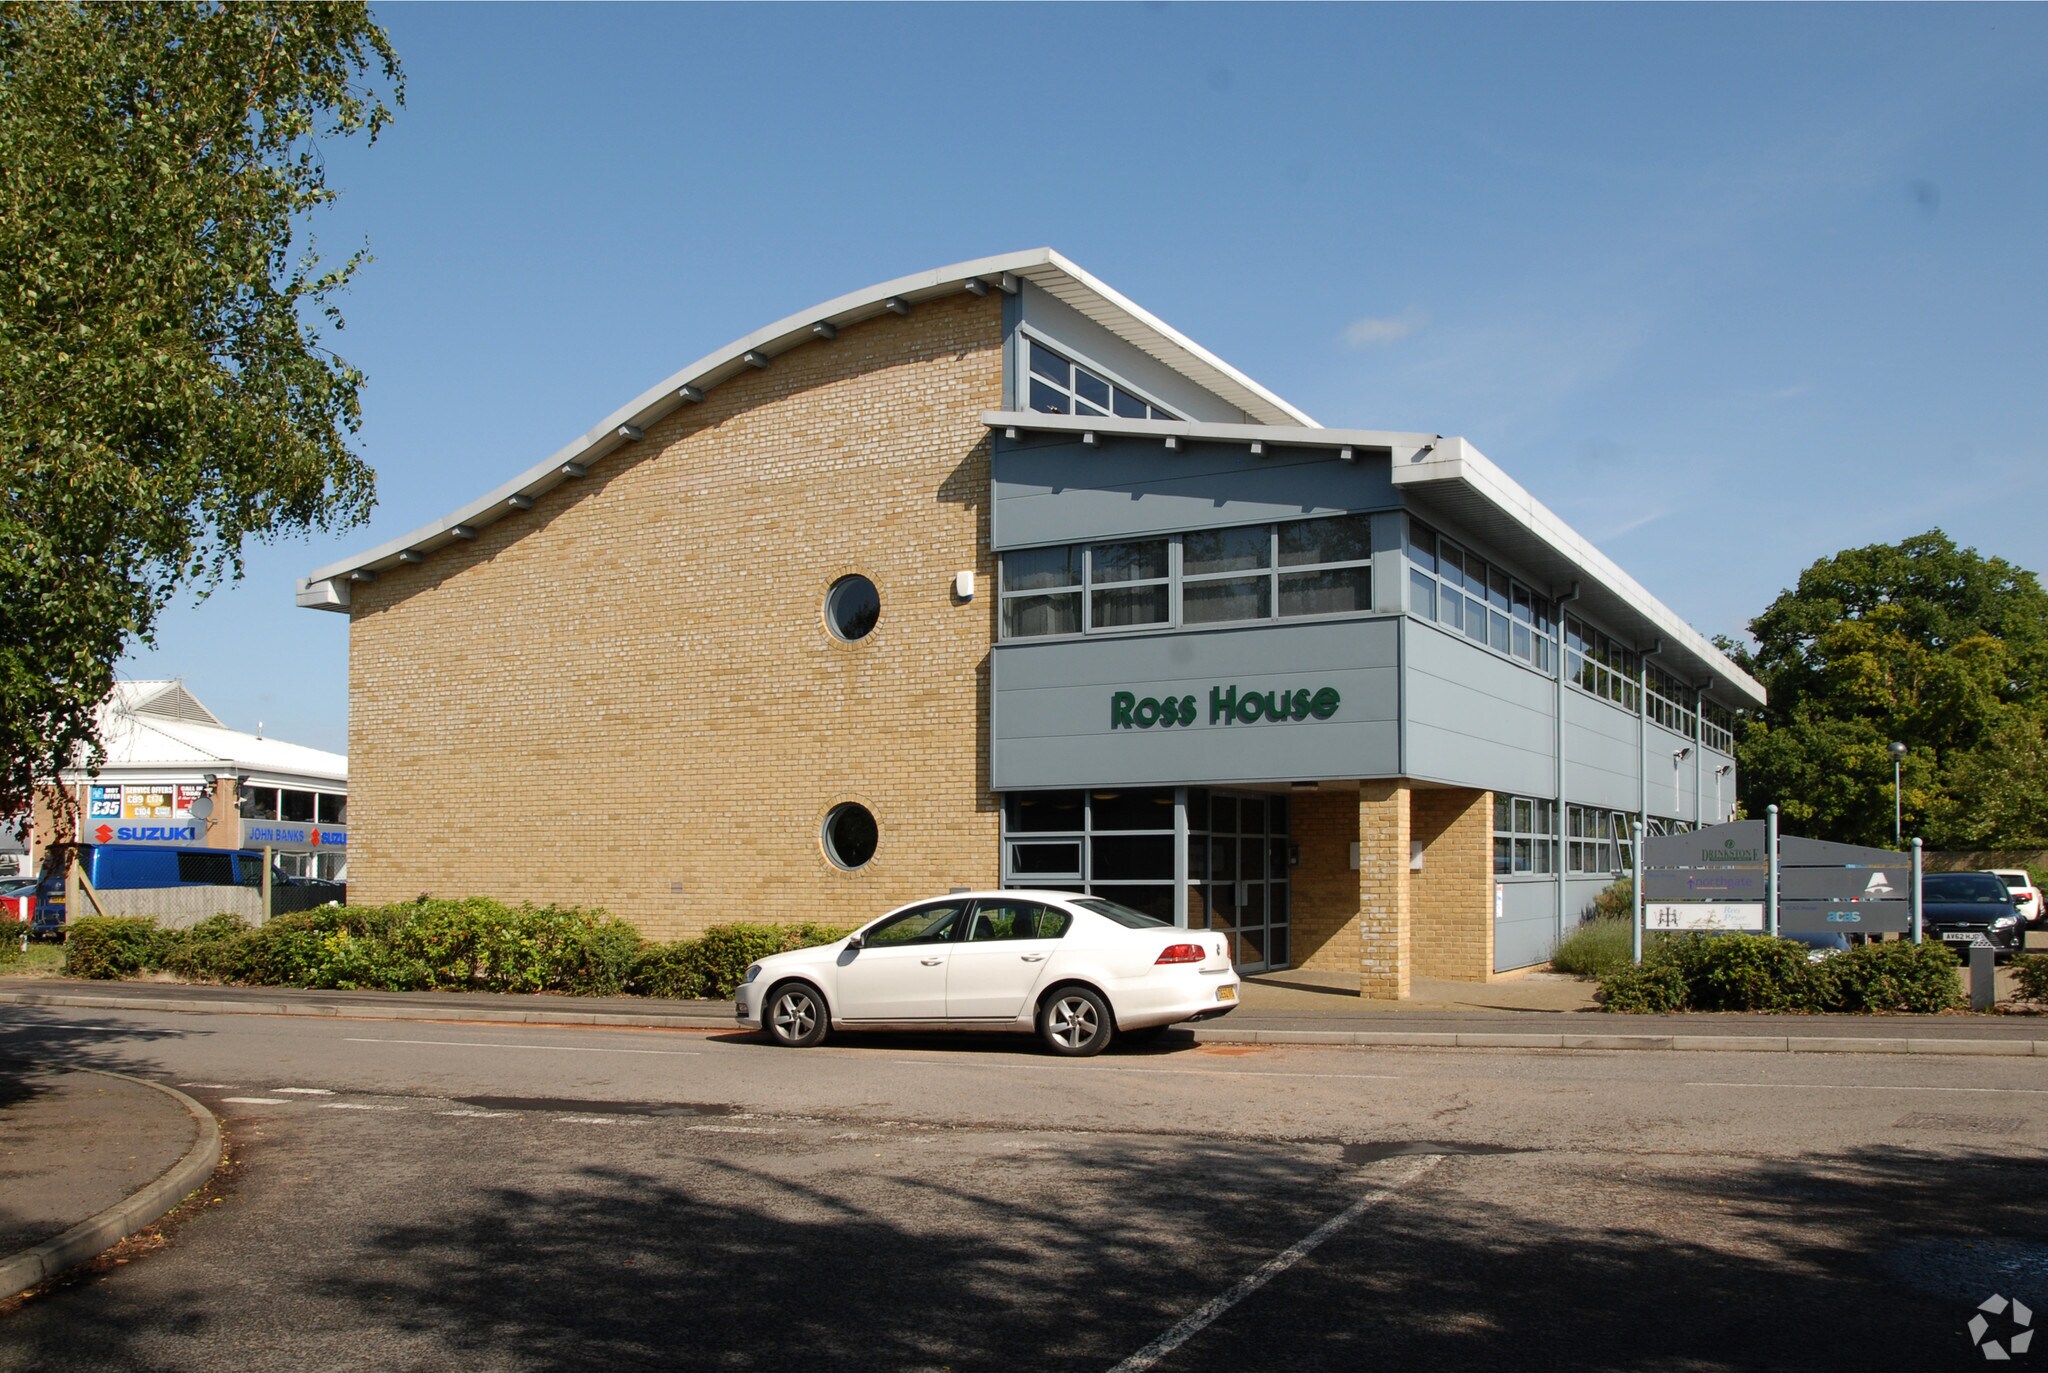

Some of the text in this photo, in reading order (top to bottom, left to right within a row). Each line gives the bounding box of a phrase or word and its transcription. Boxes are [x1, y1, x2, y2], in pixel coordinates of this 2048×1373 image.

[1112, 685, 1341, 729] Ross House
[126, 786, 173, 794] SERVICE OFFERS
[91, 801, 119, 815] £35
[117, 827, 195, 841] SUZUKI
[249, 827, 305, 842] JOHN BANKS
[321, 831, 347, 845] SUZU
[1701, 848, 1760, 862] DRINKSTONE
[1695, 877, 1753, 889] northgate
[1826, 911, 1861, 922] acas
